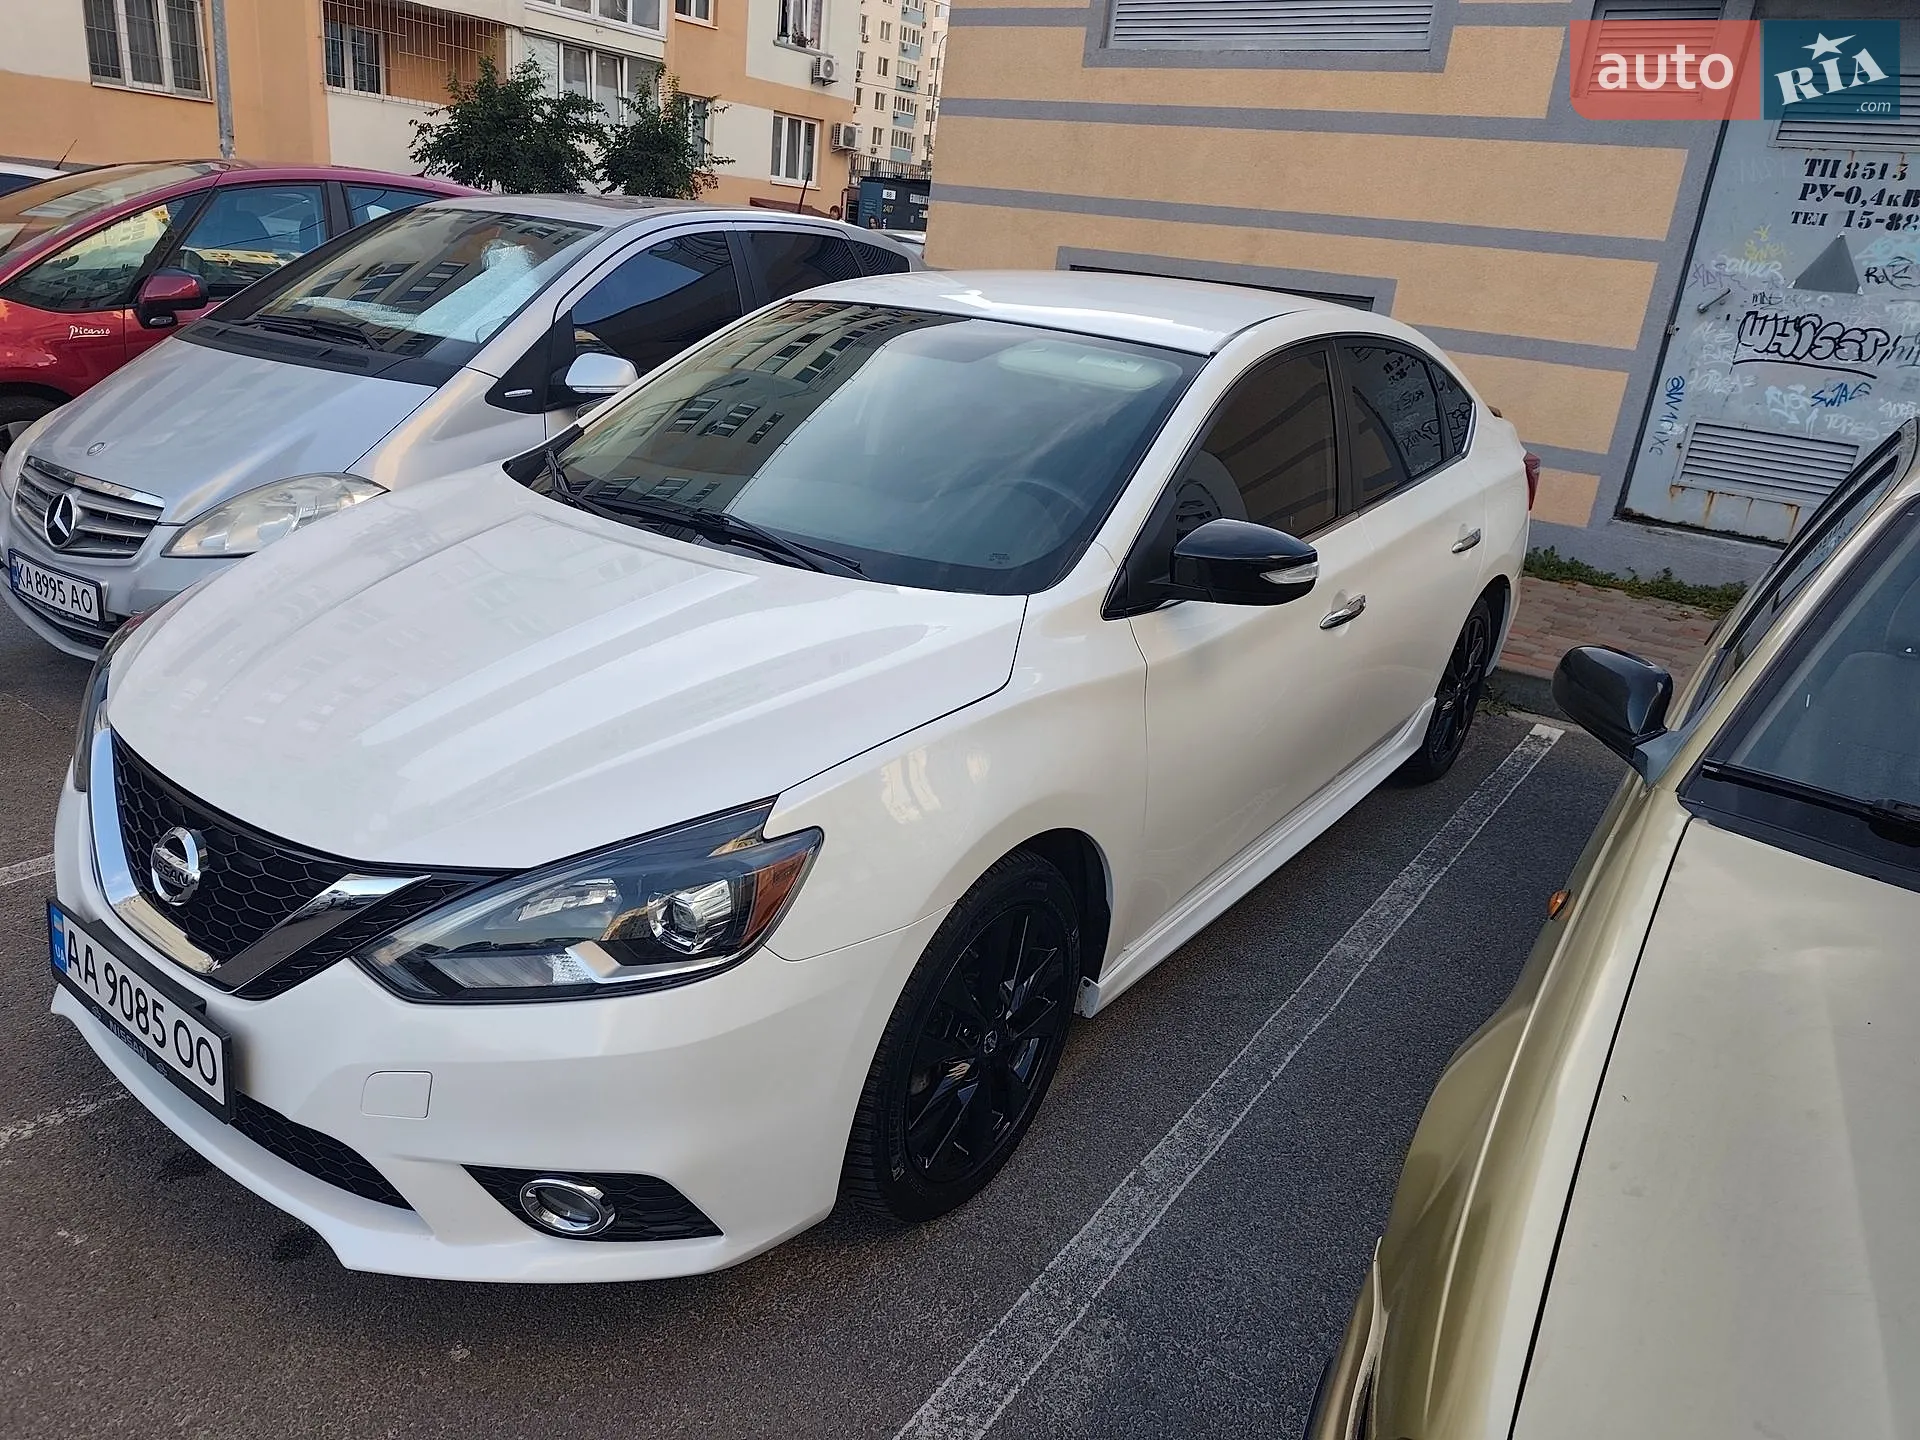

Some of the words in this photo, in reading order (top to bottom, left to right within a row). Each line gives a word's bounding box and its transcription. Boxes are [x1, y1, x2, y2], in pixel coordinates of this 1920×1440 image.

[69, 325, 111, 340] Picasso
[16, 561, 34, 591] KA
[35, 571, 66, 605] 8995
[71, 585, 92, 613] AO
[55, 945, 66, 963] UA
[68, 930, 99, 995] AA
[104, 962, 166, 1048] 9085
[174, 1020, 216, 1086] OO
[109, 1019, 149, 1062] NISSAN
